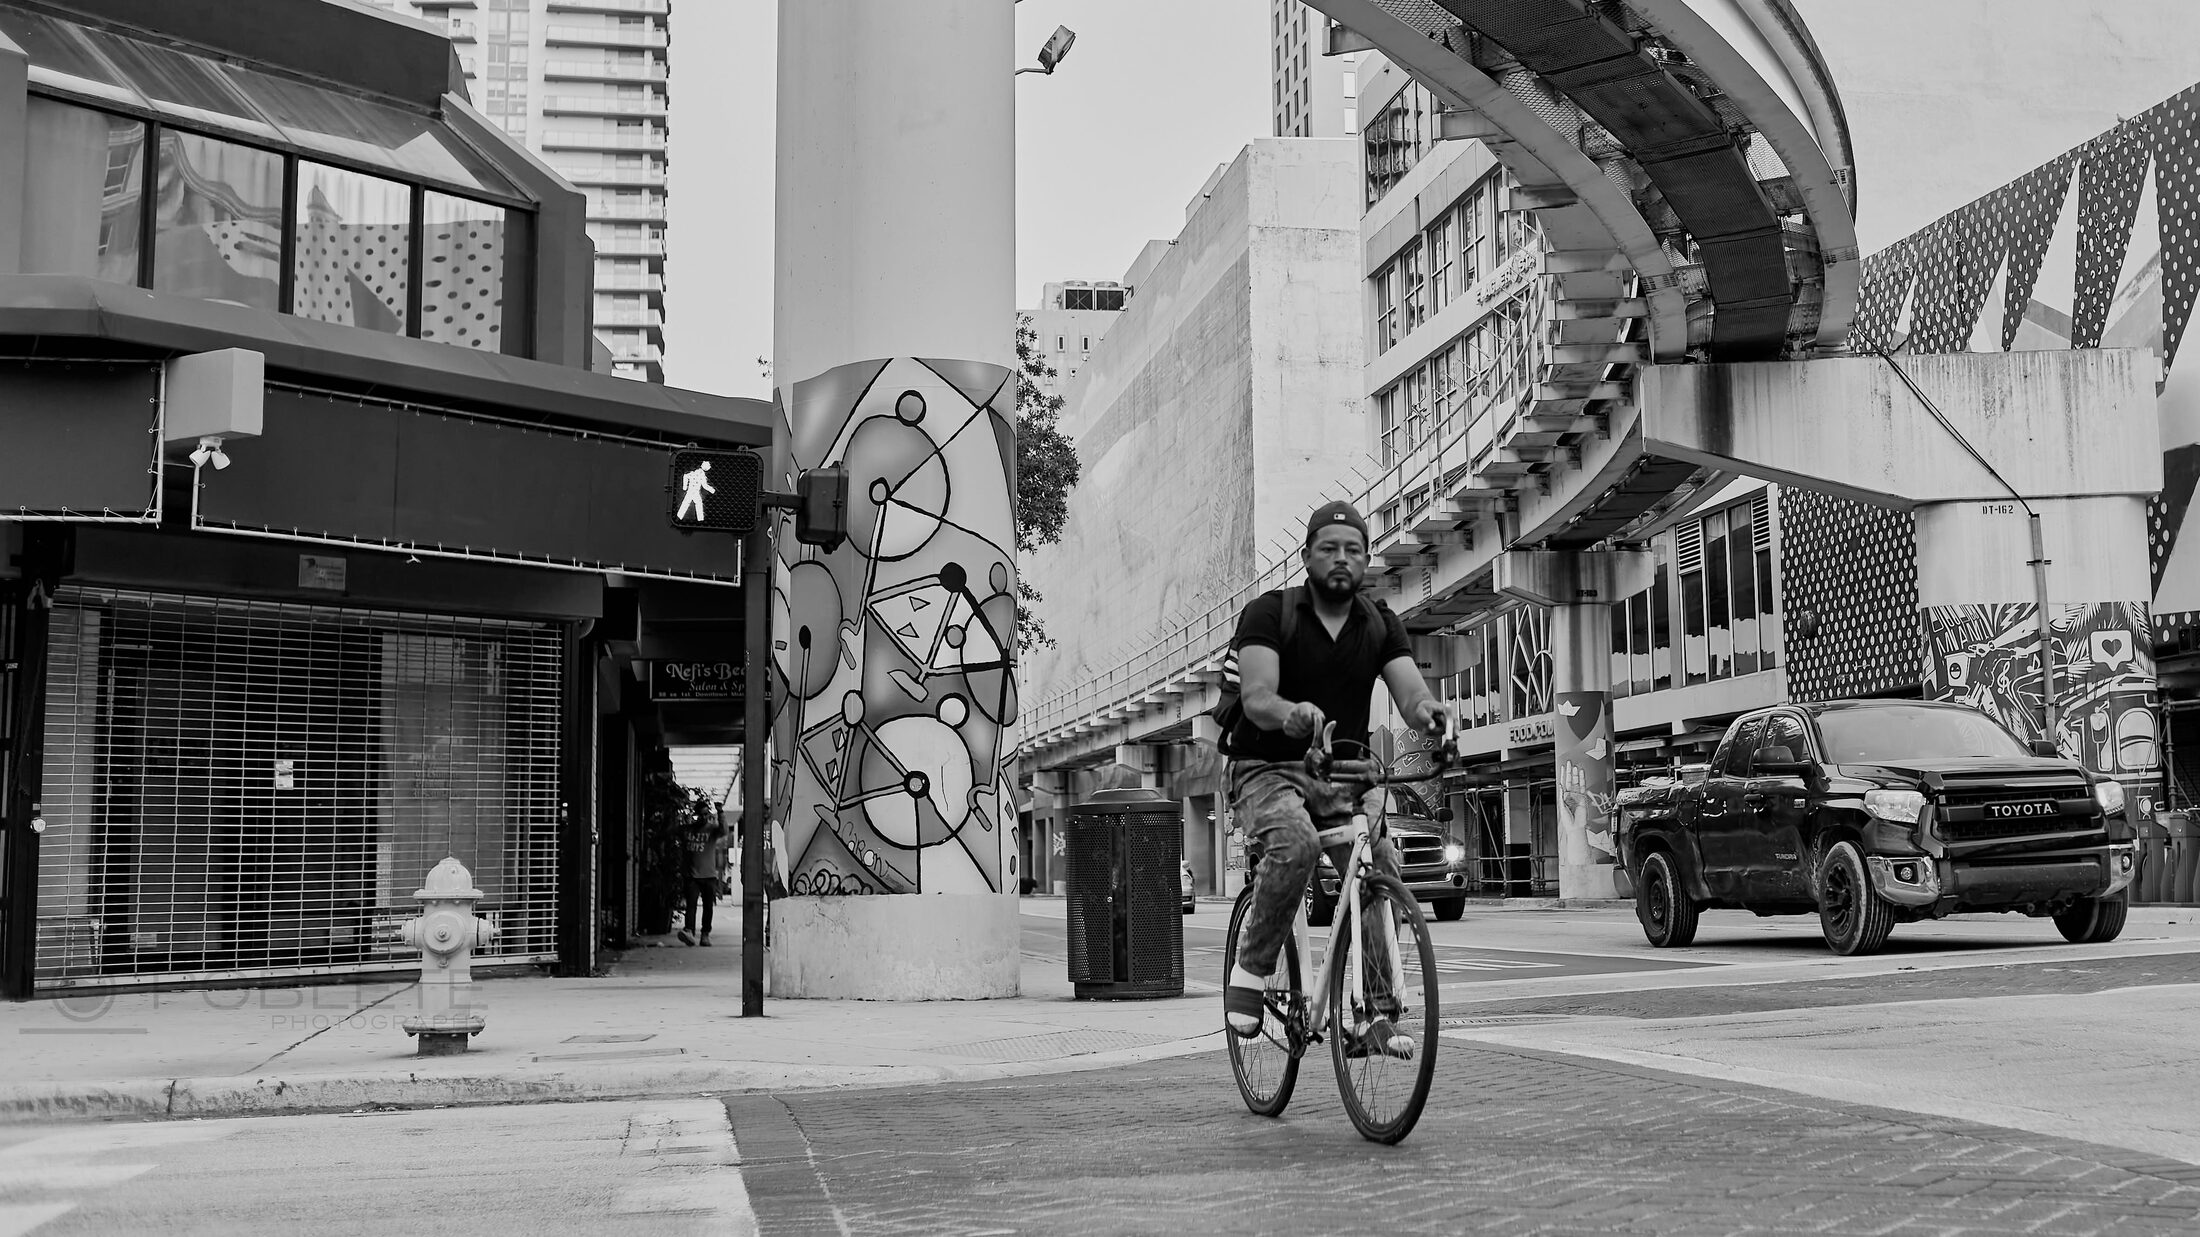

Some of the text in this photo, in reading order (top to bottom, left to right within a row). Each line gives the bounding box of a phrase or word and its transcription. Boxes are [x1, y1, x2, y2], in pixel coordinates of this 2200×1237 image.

[1982, 505, 2014, 514] DT-162
[666, 663, 712, 682] Nefi's
[689, 681, 717, 691] Salon
[1509, 723, 1533, 742] FOOD
[1991, 803, 2053, 817] TOYOTA
